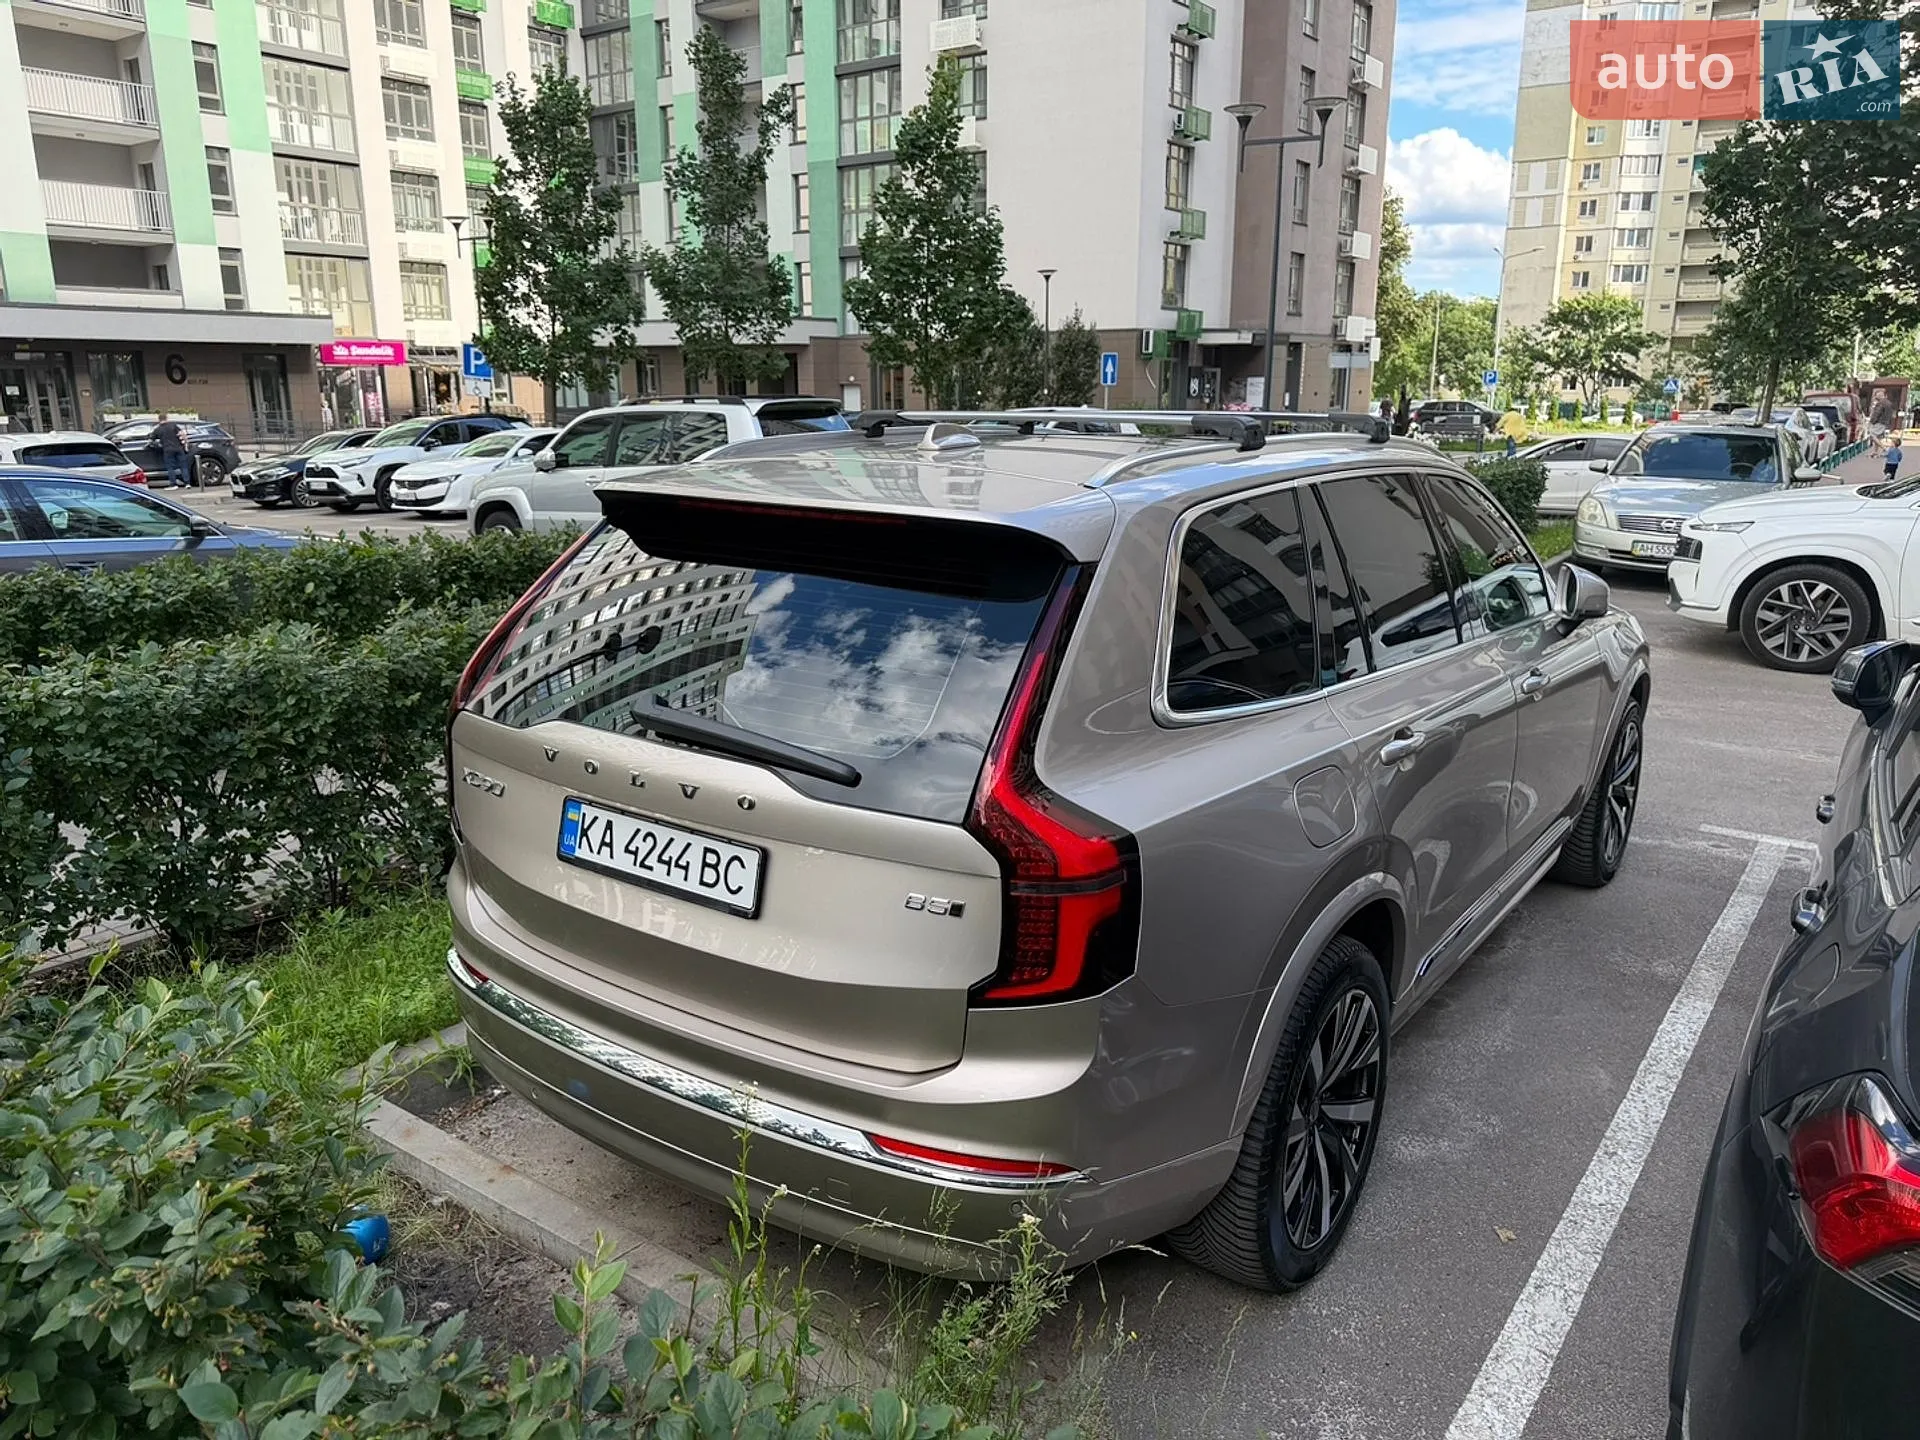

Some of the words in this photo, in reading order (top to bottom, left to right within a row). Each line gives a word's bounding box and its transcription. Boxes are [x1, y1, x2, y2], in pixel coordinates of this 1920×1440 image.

[165, 353, 187, 385] 6
[470, 347, 486, 374] P
[1486, 371, 1495, 384] P
[543, 744, 756, 811] VOLVO
[564, 833, 576, 847] UA
[578, 812, 615, 860] KA
[624, 828, 692, 882] 4244
[699, 846, 747, 895] BC
